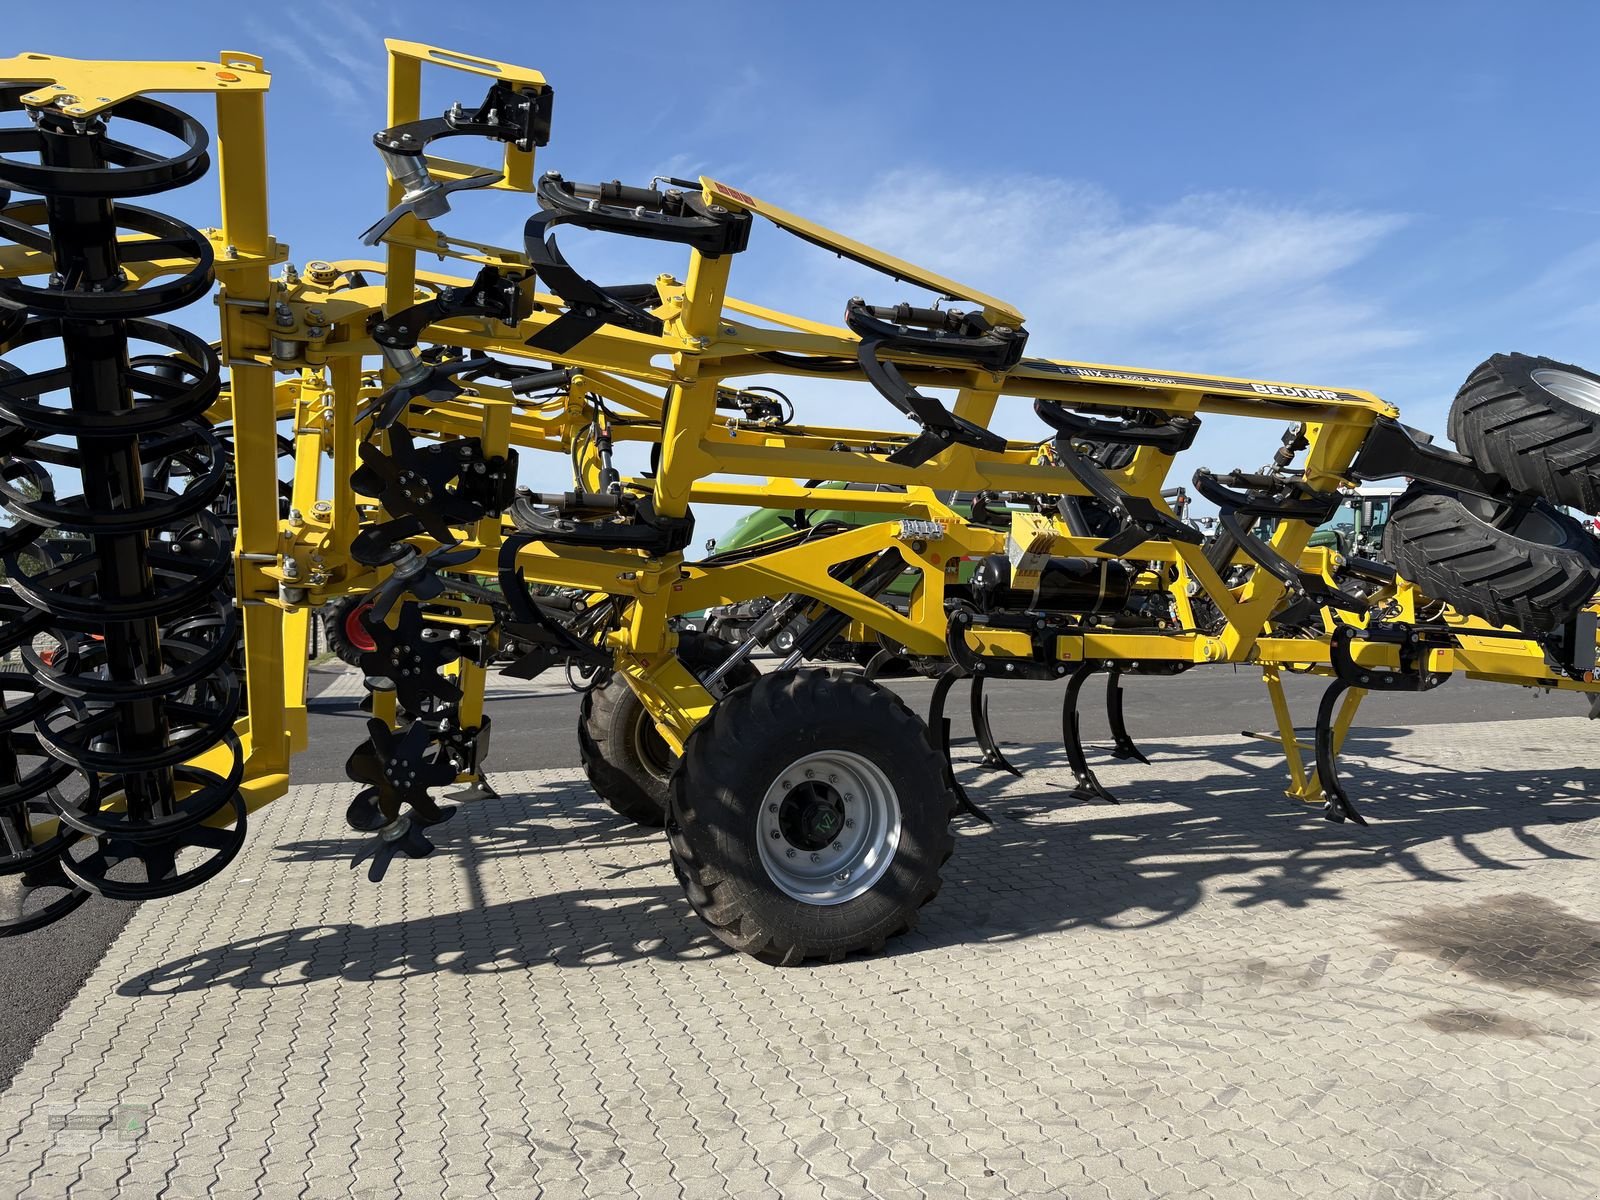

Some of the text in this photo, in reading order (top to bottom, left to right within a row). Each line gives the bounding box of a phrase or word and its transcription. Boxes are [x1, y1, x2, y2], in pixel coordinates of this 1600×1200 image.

[1059, 367, 1104, 378] FENIX
[1147, 376, 1177, 385] PROFI
[1250, 383, 1342, 401] BEDNAR
